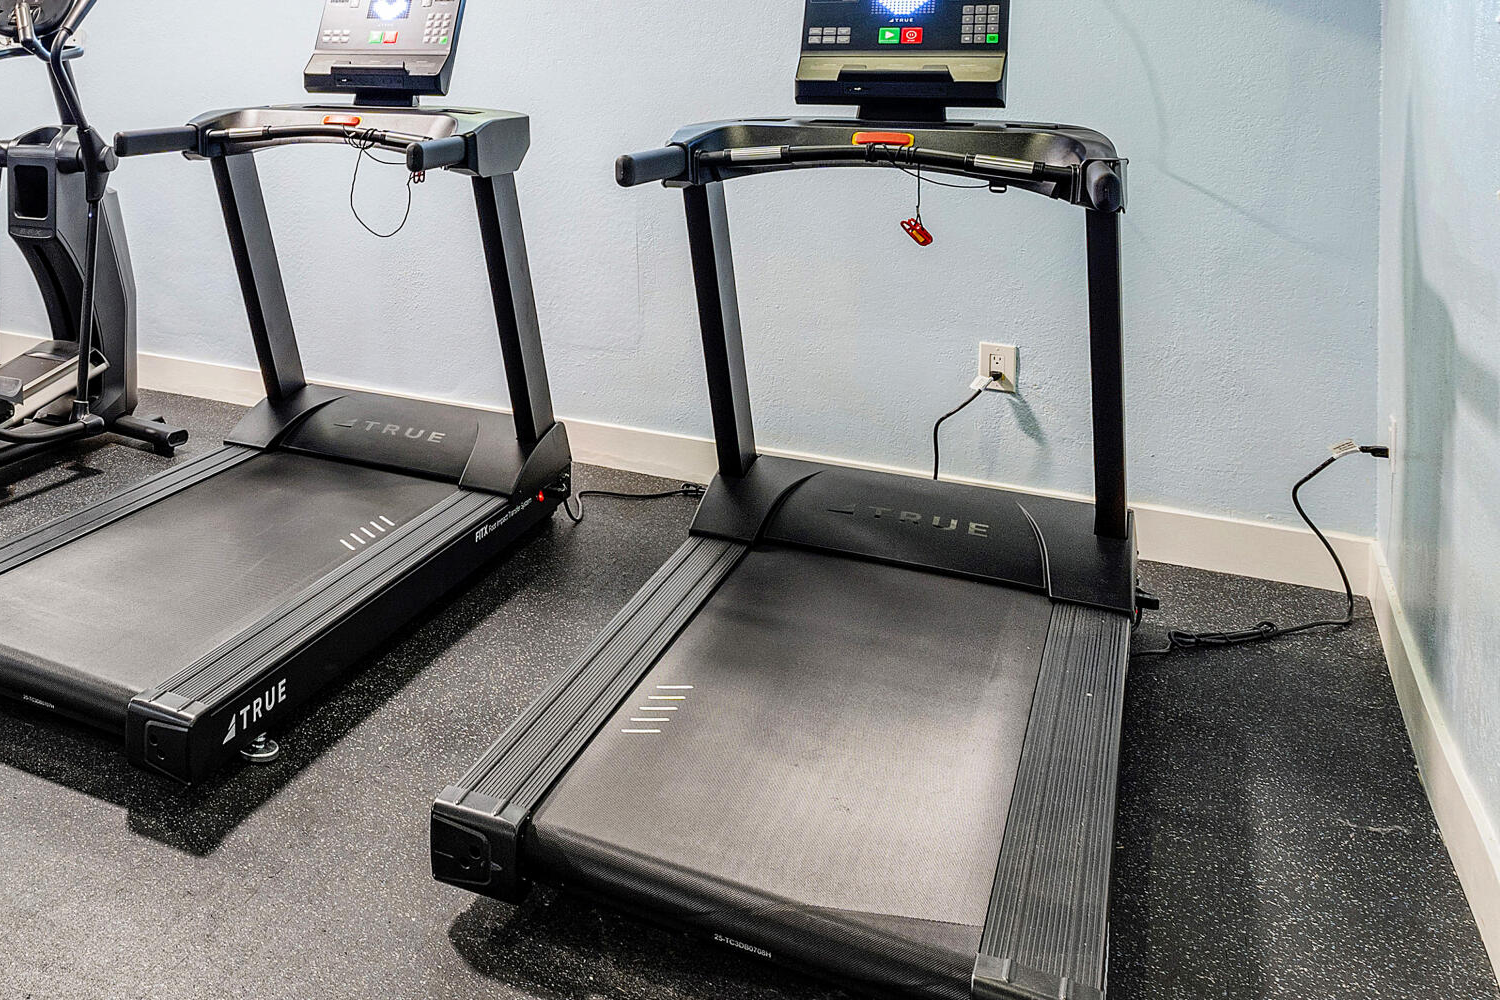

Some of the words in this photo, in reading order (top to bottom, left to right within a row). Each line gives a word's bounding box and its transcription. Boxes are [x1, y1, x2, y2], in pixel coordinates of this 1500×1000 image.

[364, 420, 446, 443] TRUE
[475, 524, 489, 543] FITX
[868, 506, 989, 538] TRUE
[239, 678, 287, 730] TRUE
